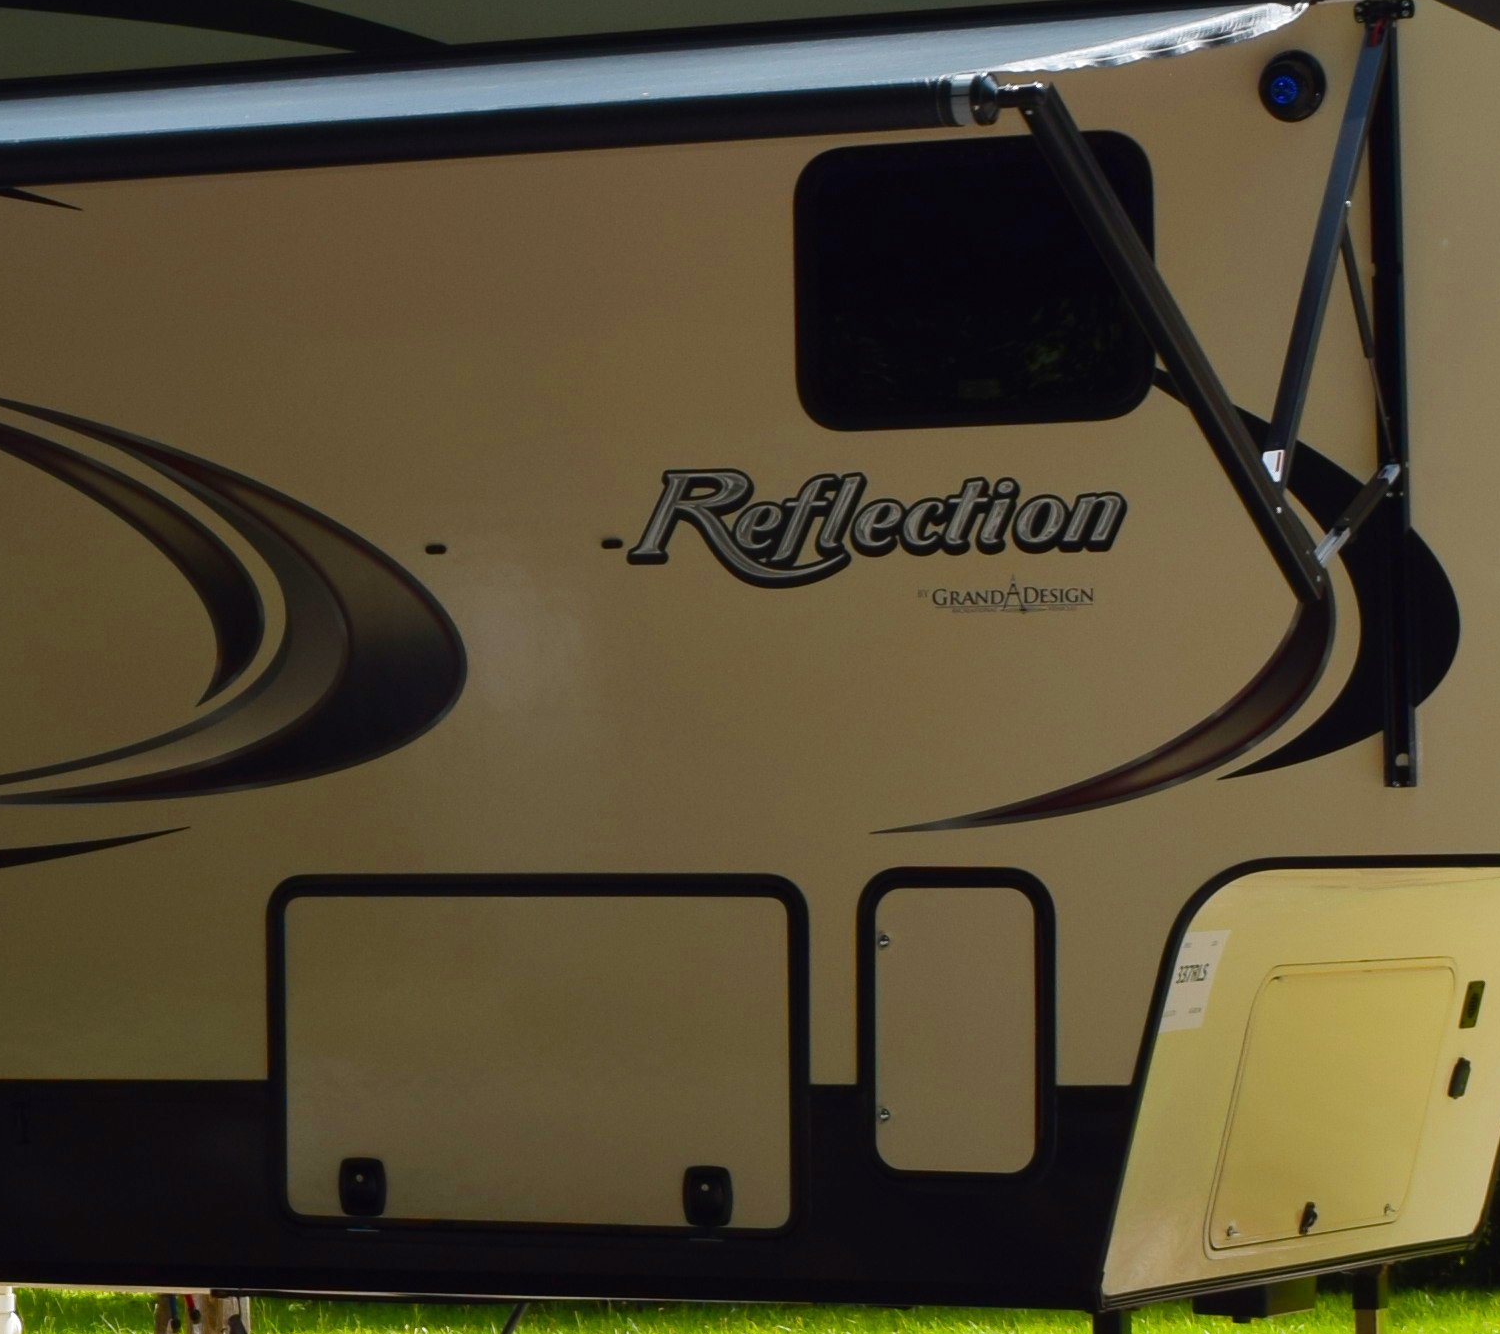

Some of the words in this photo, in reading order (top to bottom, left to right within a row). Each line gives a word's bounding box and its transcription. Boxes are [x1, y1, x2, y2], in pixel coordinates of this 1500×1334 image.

[626, 467, 1128, 589] Reflection
[932, 588, 1004, 606] GRAND
[1023, 586, 1094, 604] DESIGN
